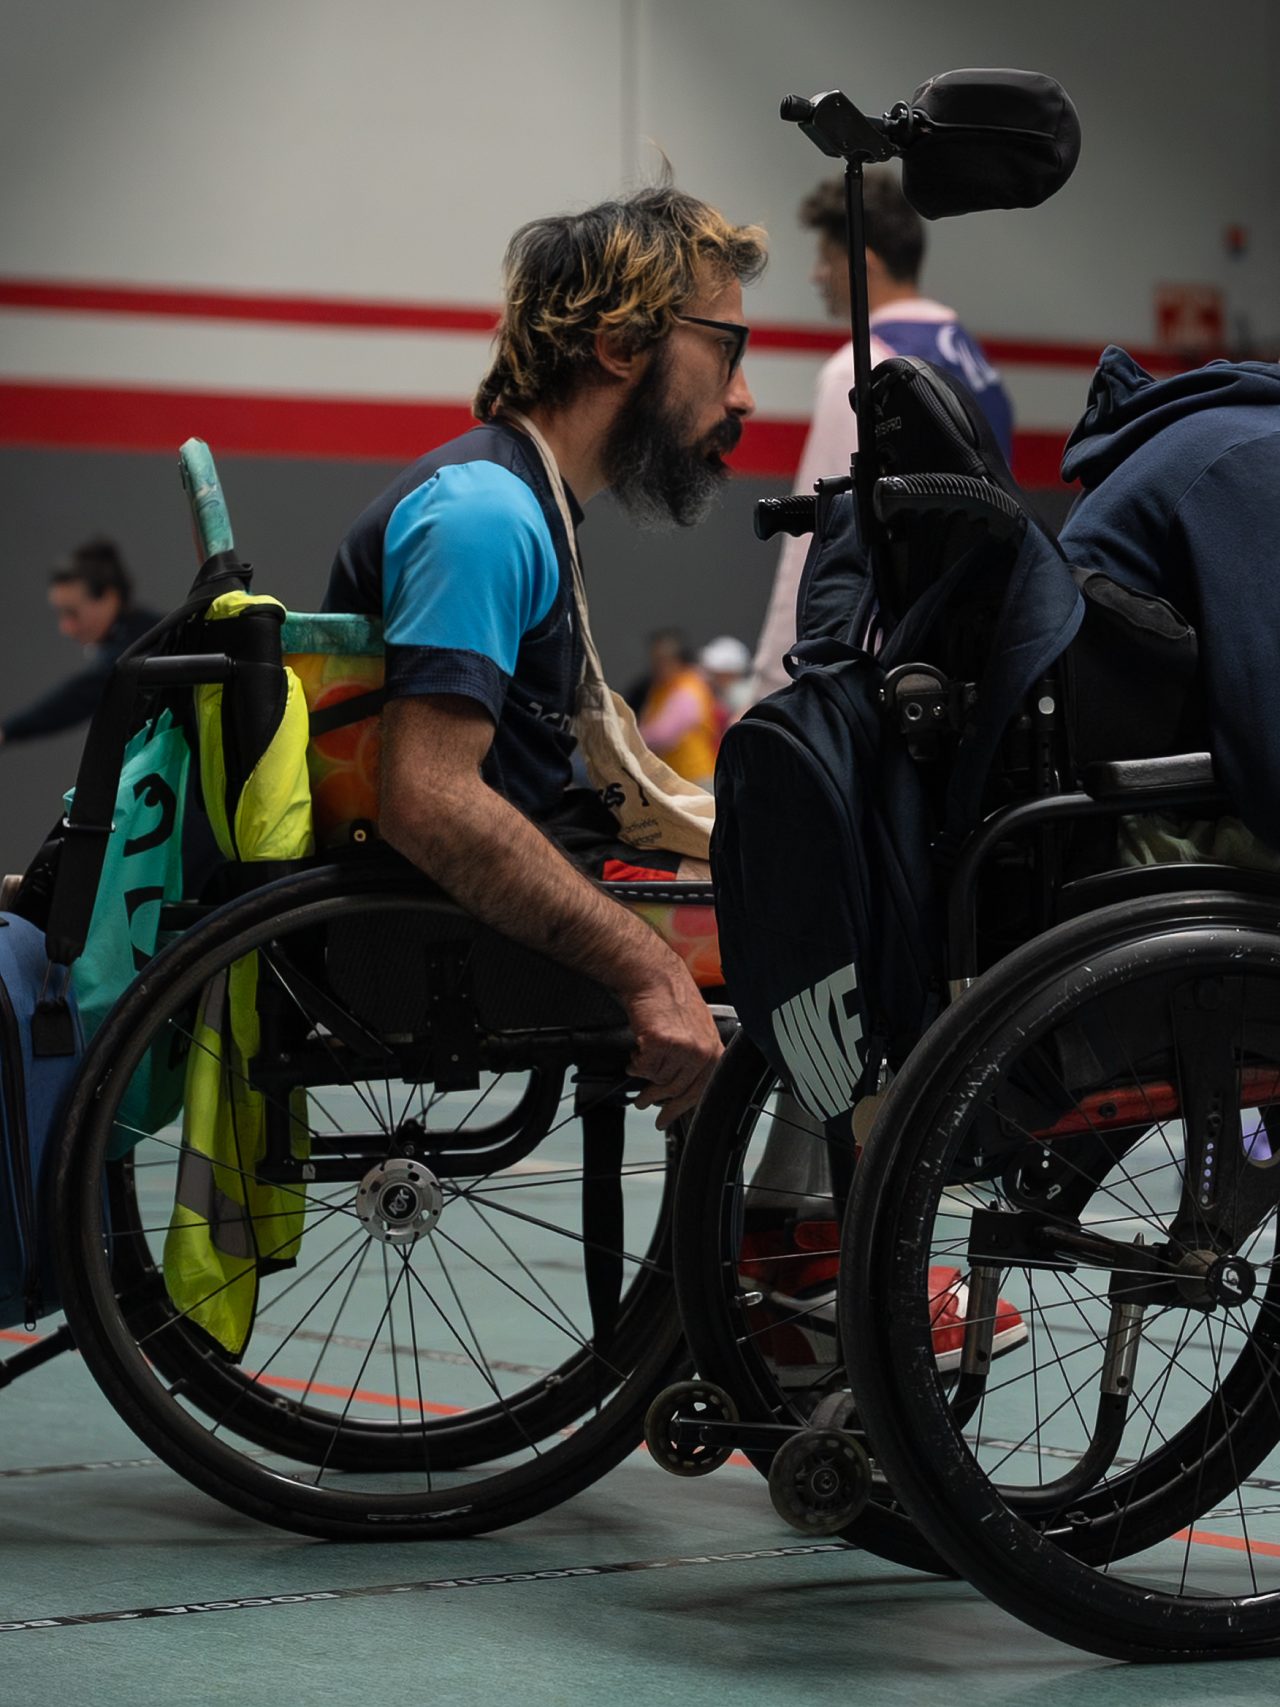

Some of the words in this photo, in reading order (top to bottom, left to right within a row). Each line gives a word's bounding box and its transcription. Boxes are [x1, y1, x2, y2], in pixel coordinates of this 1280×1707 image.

[771, 962, 864, 1122] NIKE
[679, 1544, 846, 1563] BOCCIA
[429, 1567, 600, 1588] BOCCIA
[154, 1593, 341, 1614] BOCCIA
